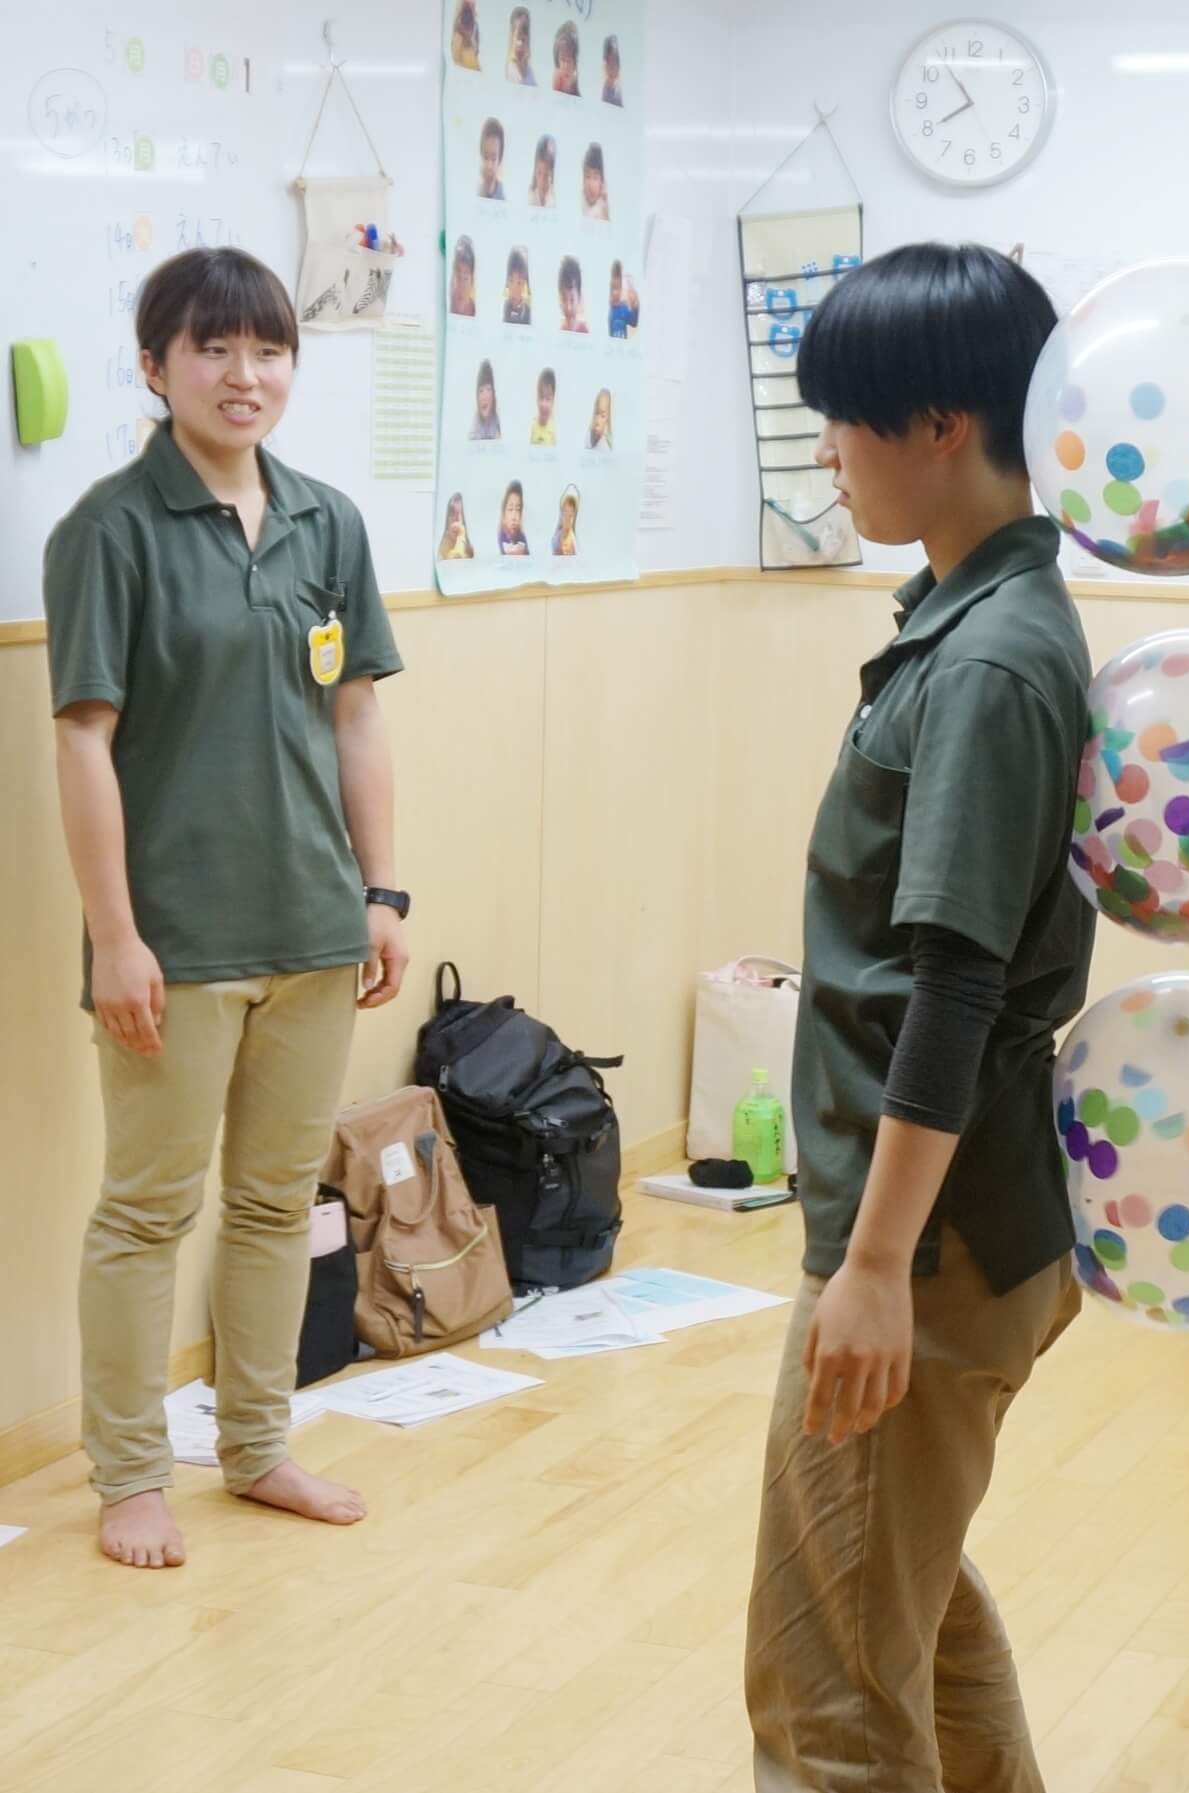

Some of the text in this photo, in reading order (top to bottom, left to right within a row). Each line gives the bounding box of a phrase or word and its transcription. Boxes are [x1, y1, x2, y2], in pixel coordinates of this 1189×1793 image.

[967, 39, 984, 58] 12
[922, 65, 940, 83] 10
[1011, 68, 1024, 86] 2
[914, 91, 928, 110] 9
[1017, 96, 1030, 114] 3
[921, 119, 934, 137] 8
[1007, 122, 1021, 140] 4
[940, 140, 952, 157] 7
[963, 148, 976, 166] 6
[989, 142, 1002, 160] 5
